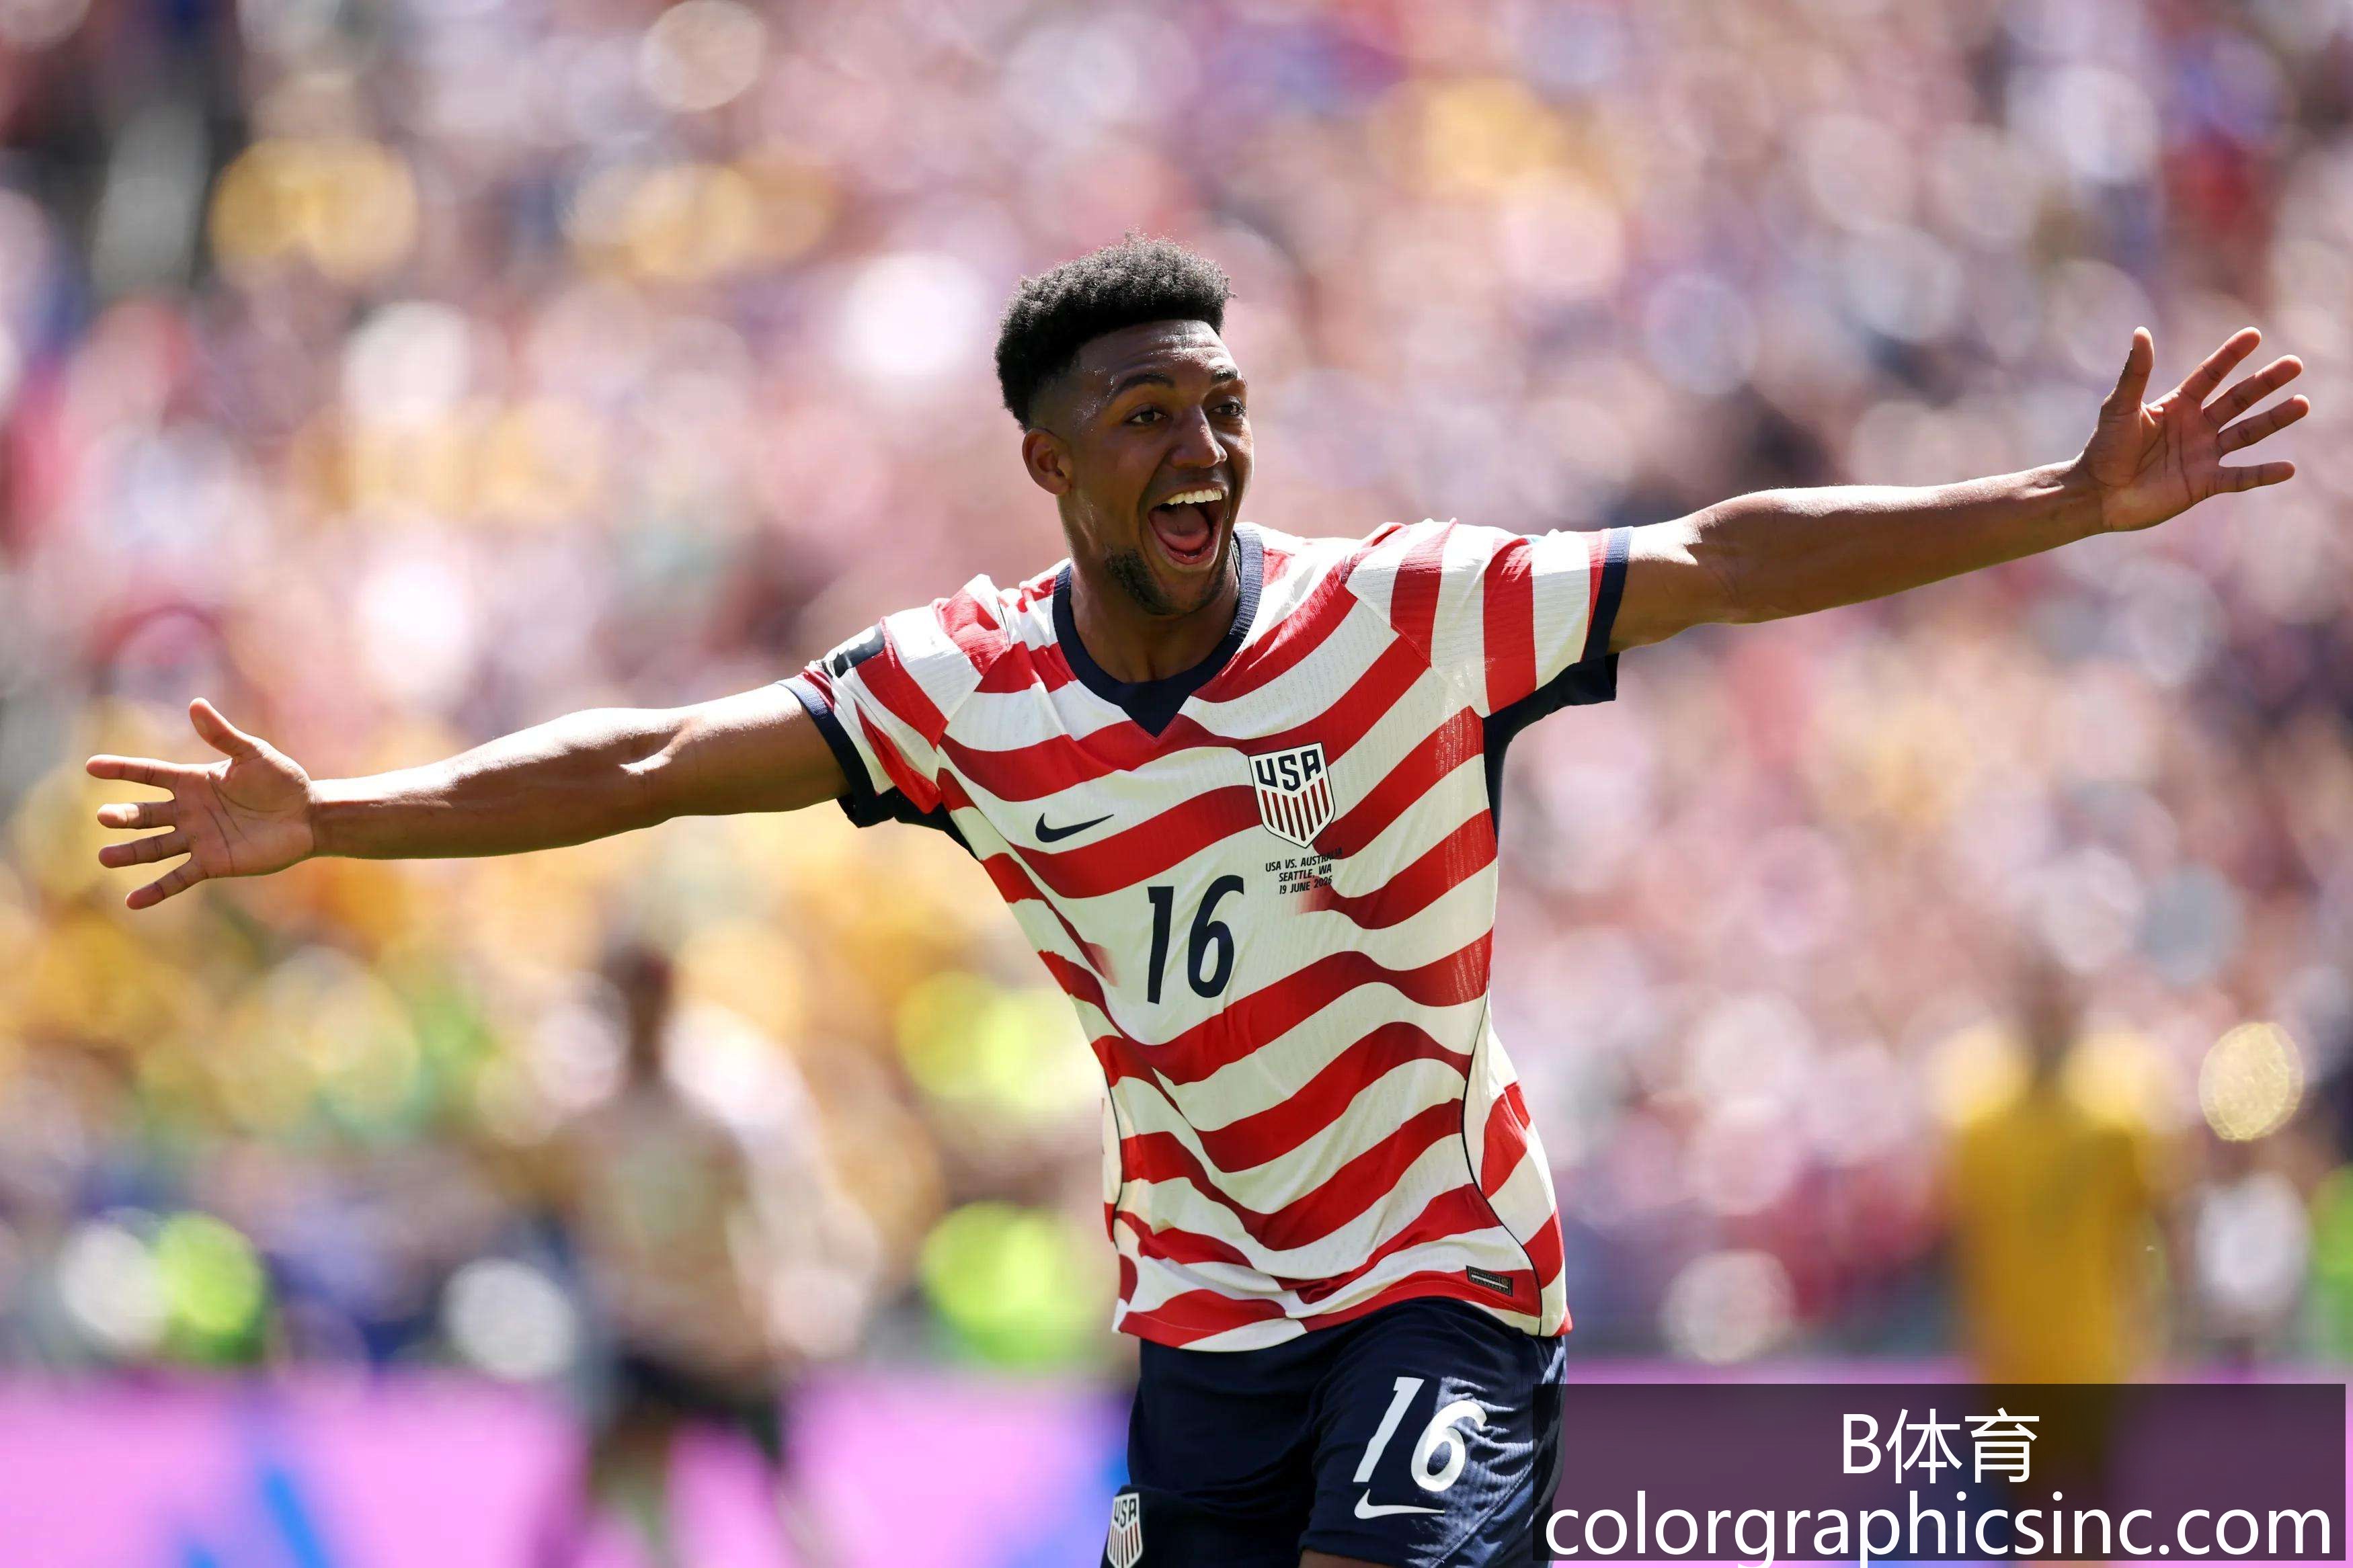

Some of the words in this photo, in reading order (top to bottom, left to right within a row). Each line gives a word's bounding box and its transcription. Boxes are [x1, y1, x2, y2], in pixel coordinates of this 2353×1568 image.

[1255, 749, 1321, 791] USA
[1265, 861, 1281, 872] USA
[1285, 859, 1297, 868] VS.
[1279, 869, 1315, 882] SEATTLE,
[1318, 864, 1332, 875] WA
[1279, 884, 1287, 895] 19
[1290, 881, 1310, 893] JUNE
[1314, 875, 1332, 889] 2026
[1148, 874, 1244, 1004] 16
[1353, 1376, 1486, 1492] 16
[1114, 1498, 1136, 1528] USA
